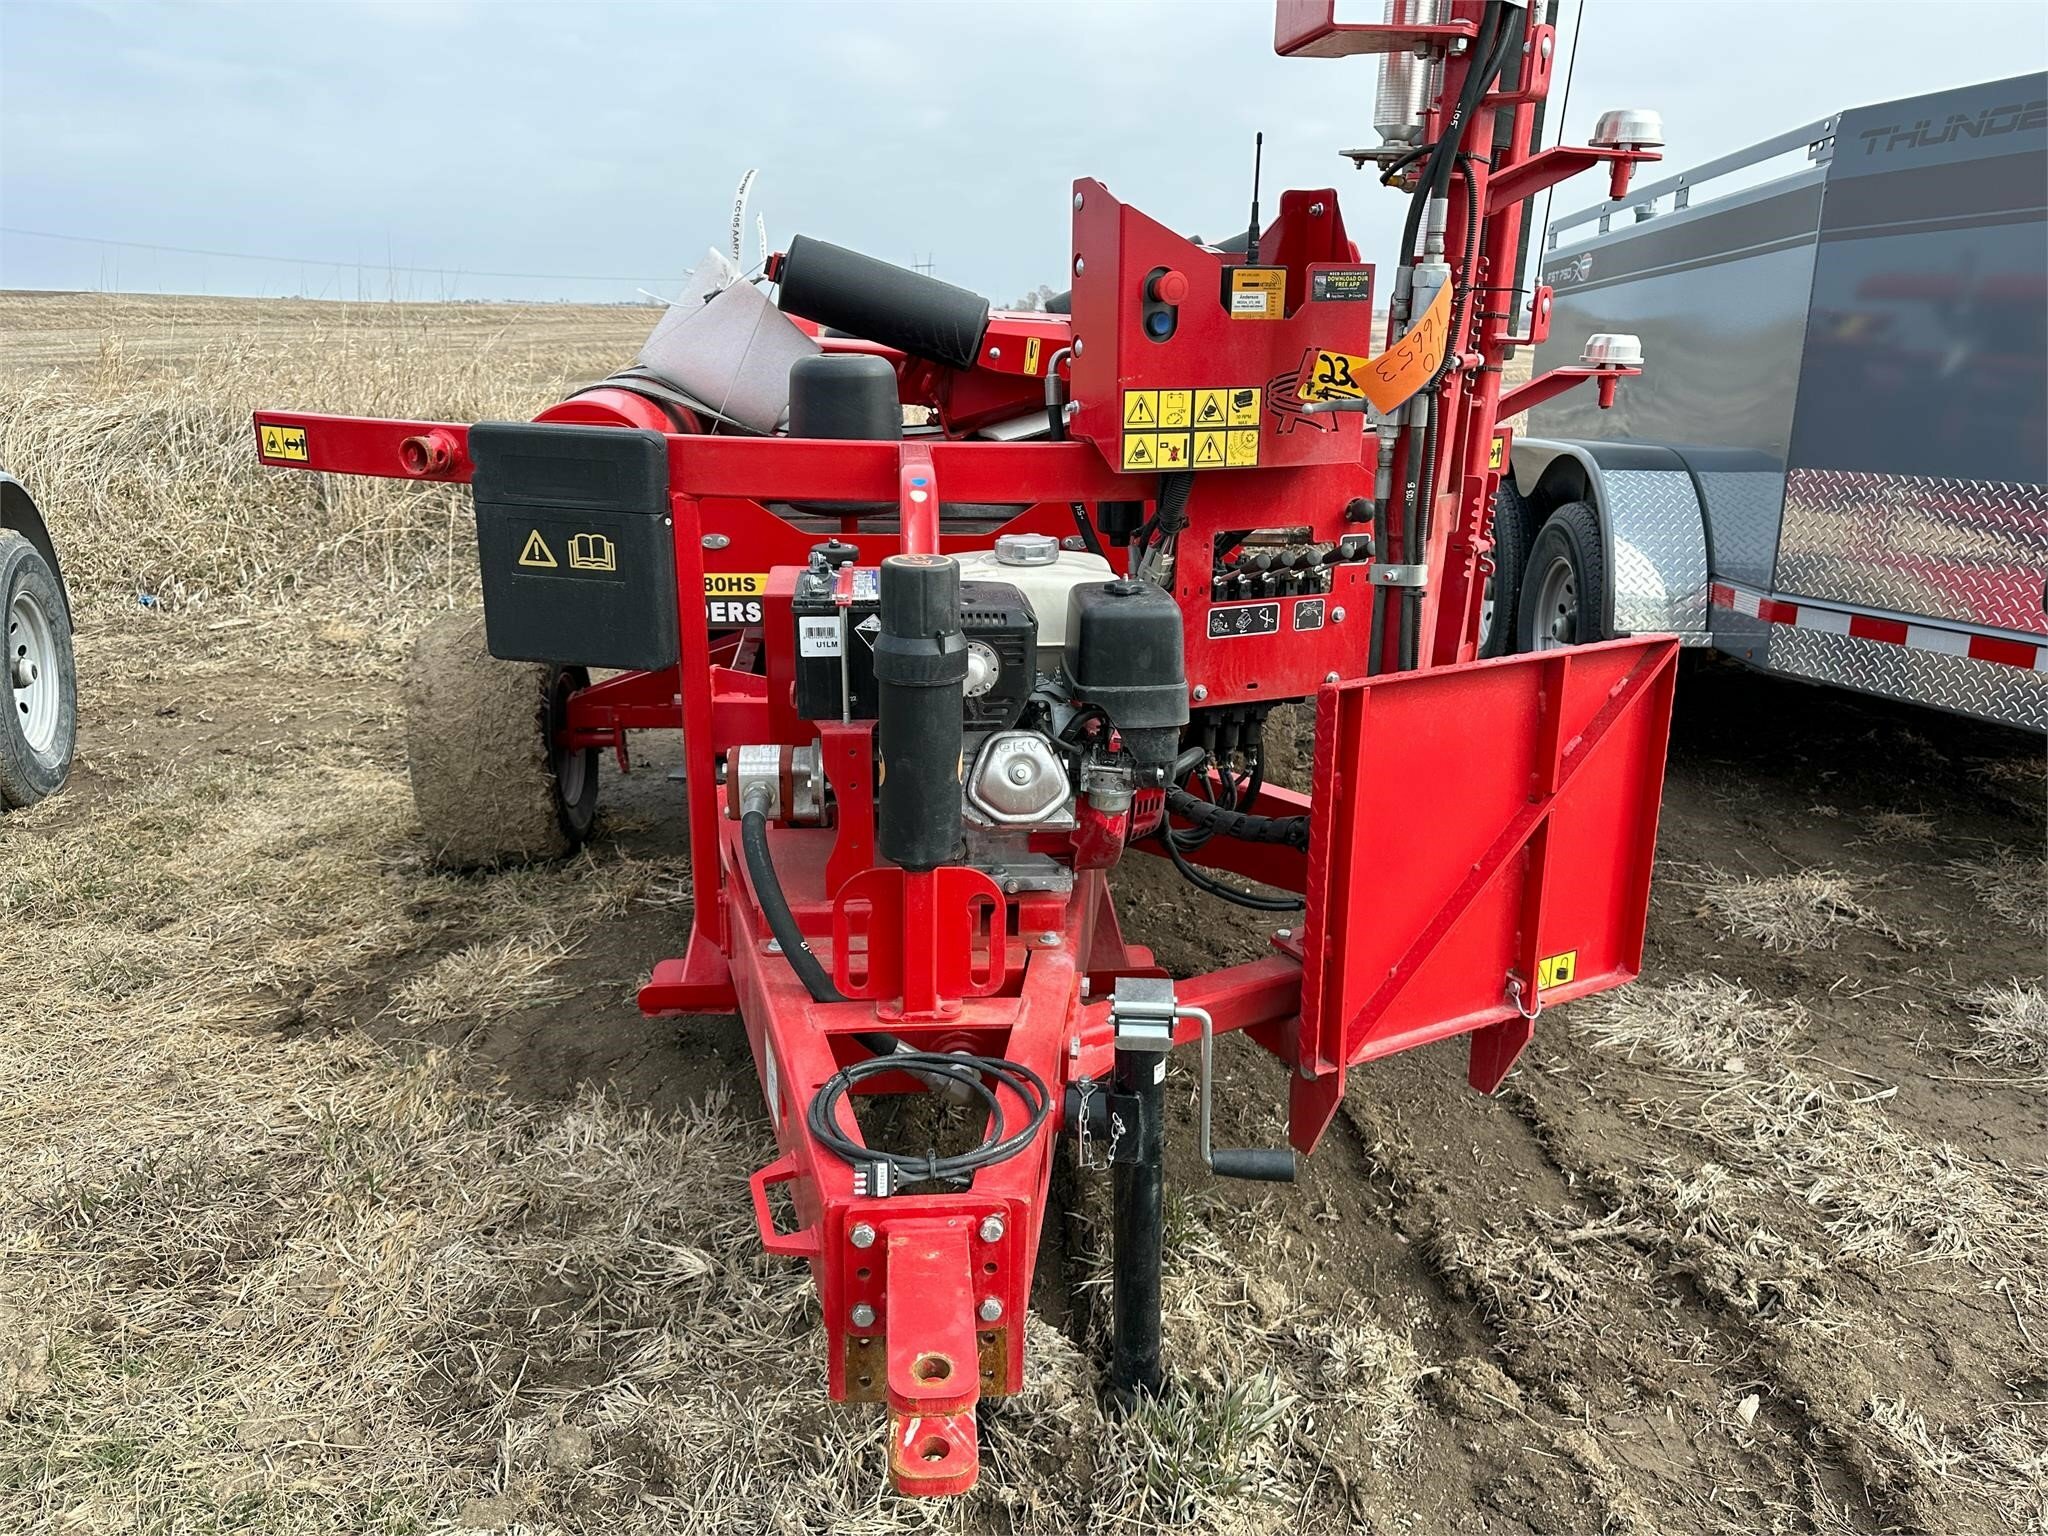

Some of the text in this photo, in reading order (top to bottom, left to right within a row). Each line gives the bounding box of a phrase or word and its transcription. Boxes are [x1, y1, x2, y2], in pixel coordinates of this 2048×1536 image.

[733, 199, 743, 228] CC105
[1375, 306, 1442, 383] 16653
[705, 601, 762, 623] ERS
